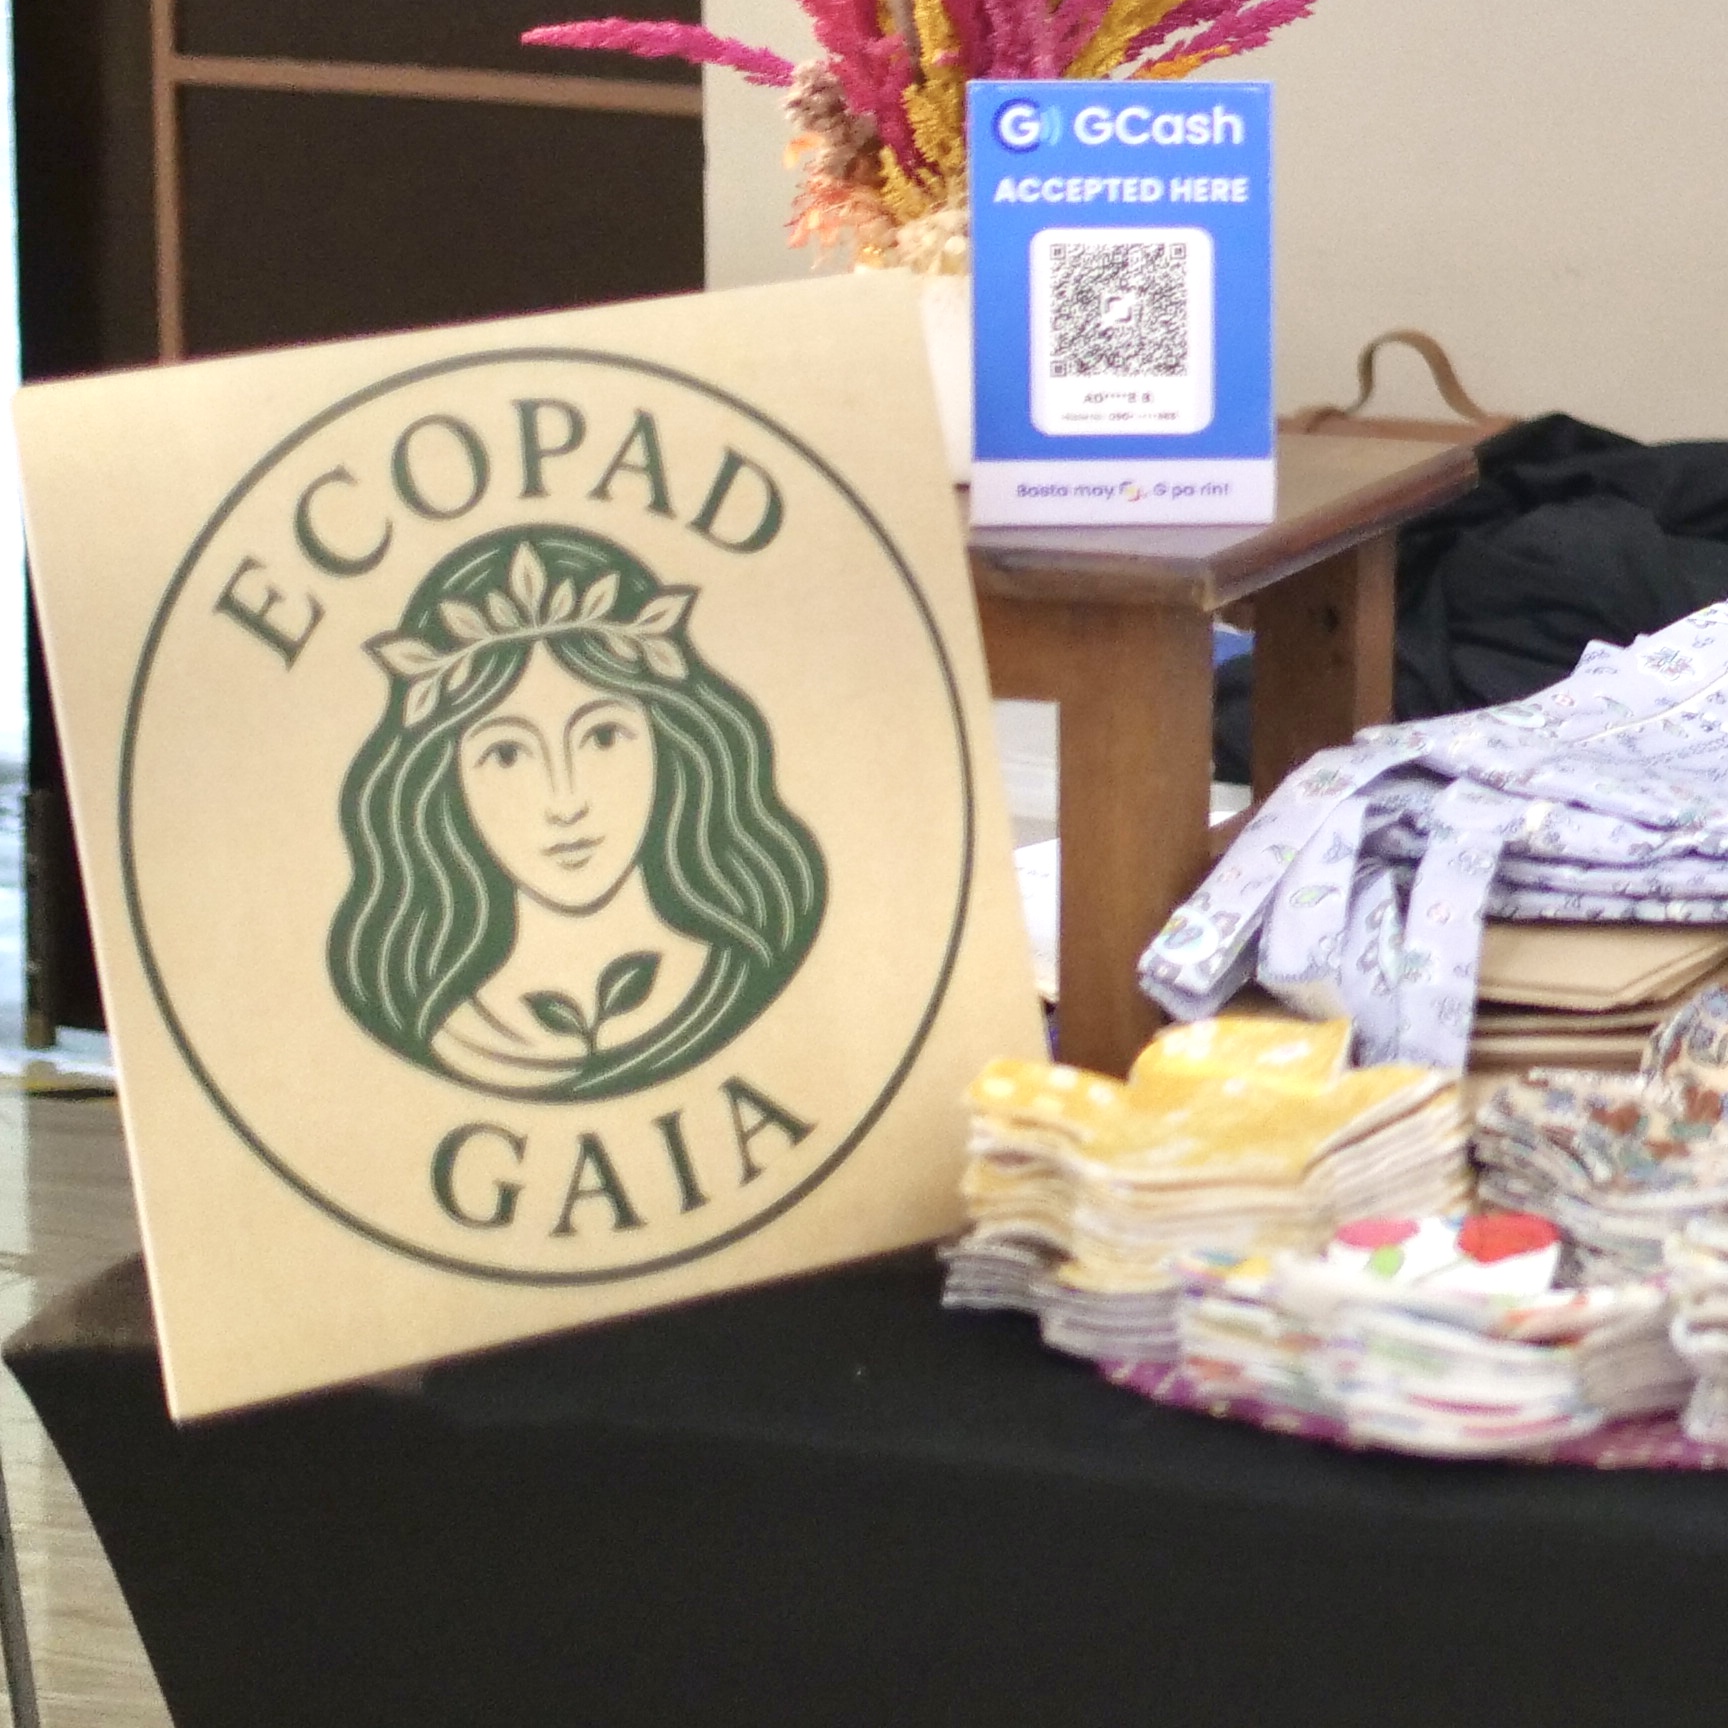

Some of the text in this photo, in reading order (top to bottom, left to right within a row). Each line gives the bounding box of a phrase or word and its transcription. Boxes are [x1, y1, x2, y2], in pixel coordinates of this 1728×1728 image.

[1072, 104, 1246, 147] GCash
[993, 175, 1250, 204] ACCEPTED HERE
[1016, 483, 1069, 498] Basta
[1073, 484, 1116, 500] may
[1171, 485, 1196, 500] pa
[213, 396, 786, 672] ECOPAD
[428, 1074, 818, 1237] GAIA
